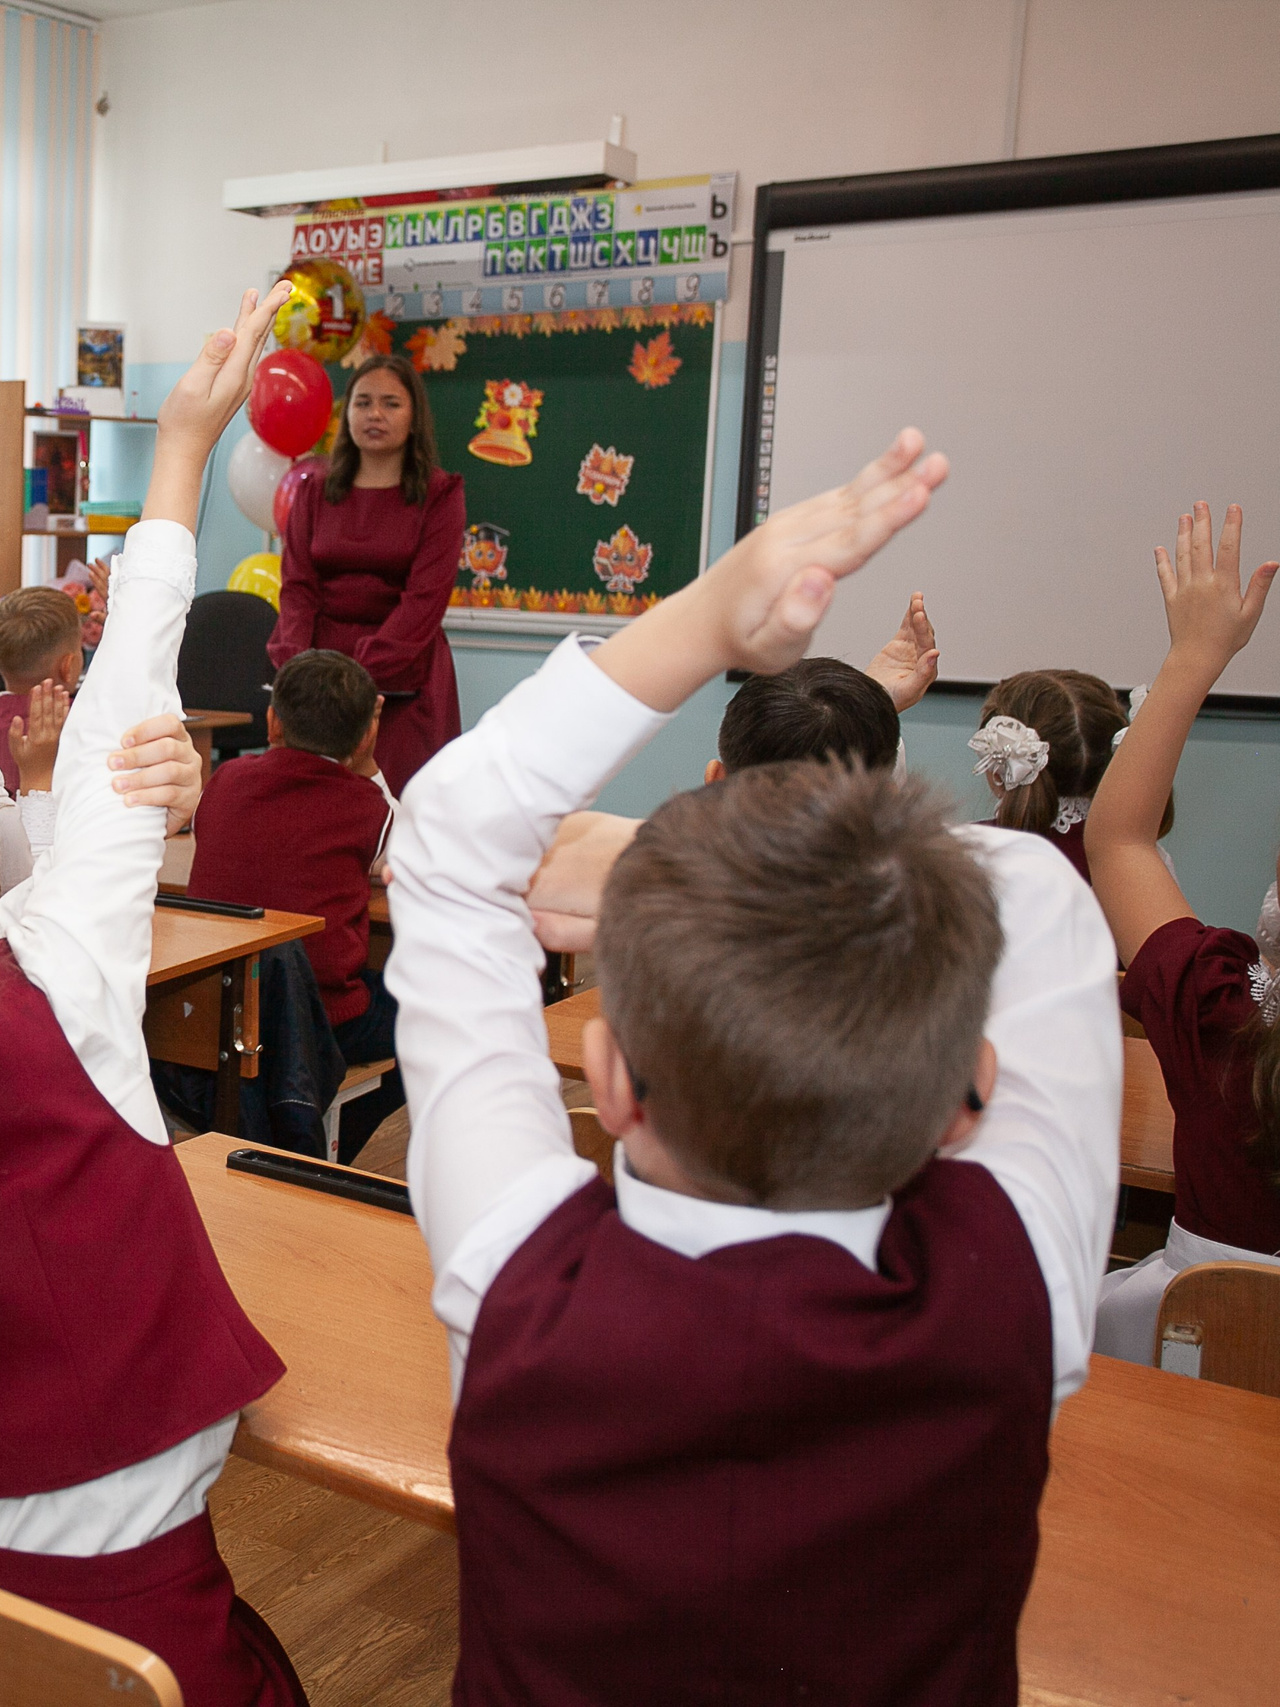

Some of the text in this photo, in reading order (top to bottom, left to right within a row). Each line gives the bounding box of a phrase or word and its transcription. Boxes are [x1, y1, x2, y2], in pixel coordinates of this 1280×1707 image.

[325, 283, 344, 320] 1
[389, 273, 701, 319] 2 3 4 5 6 7 8 9
